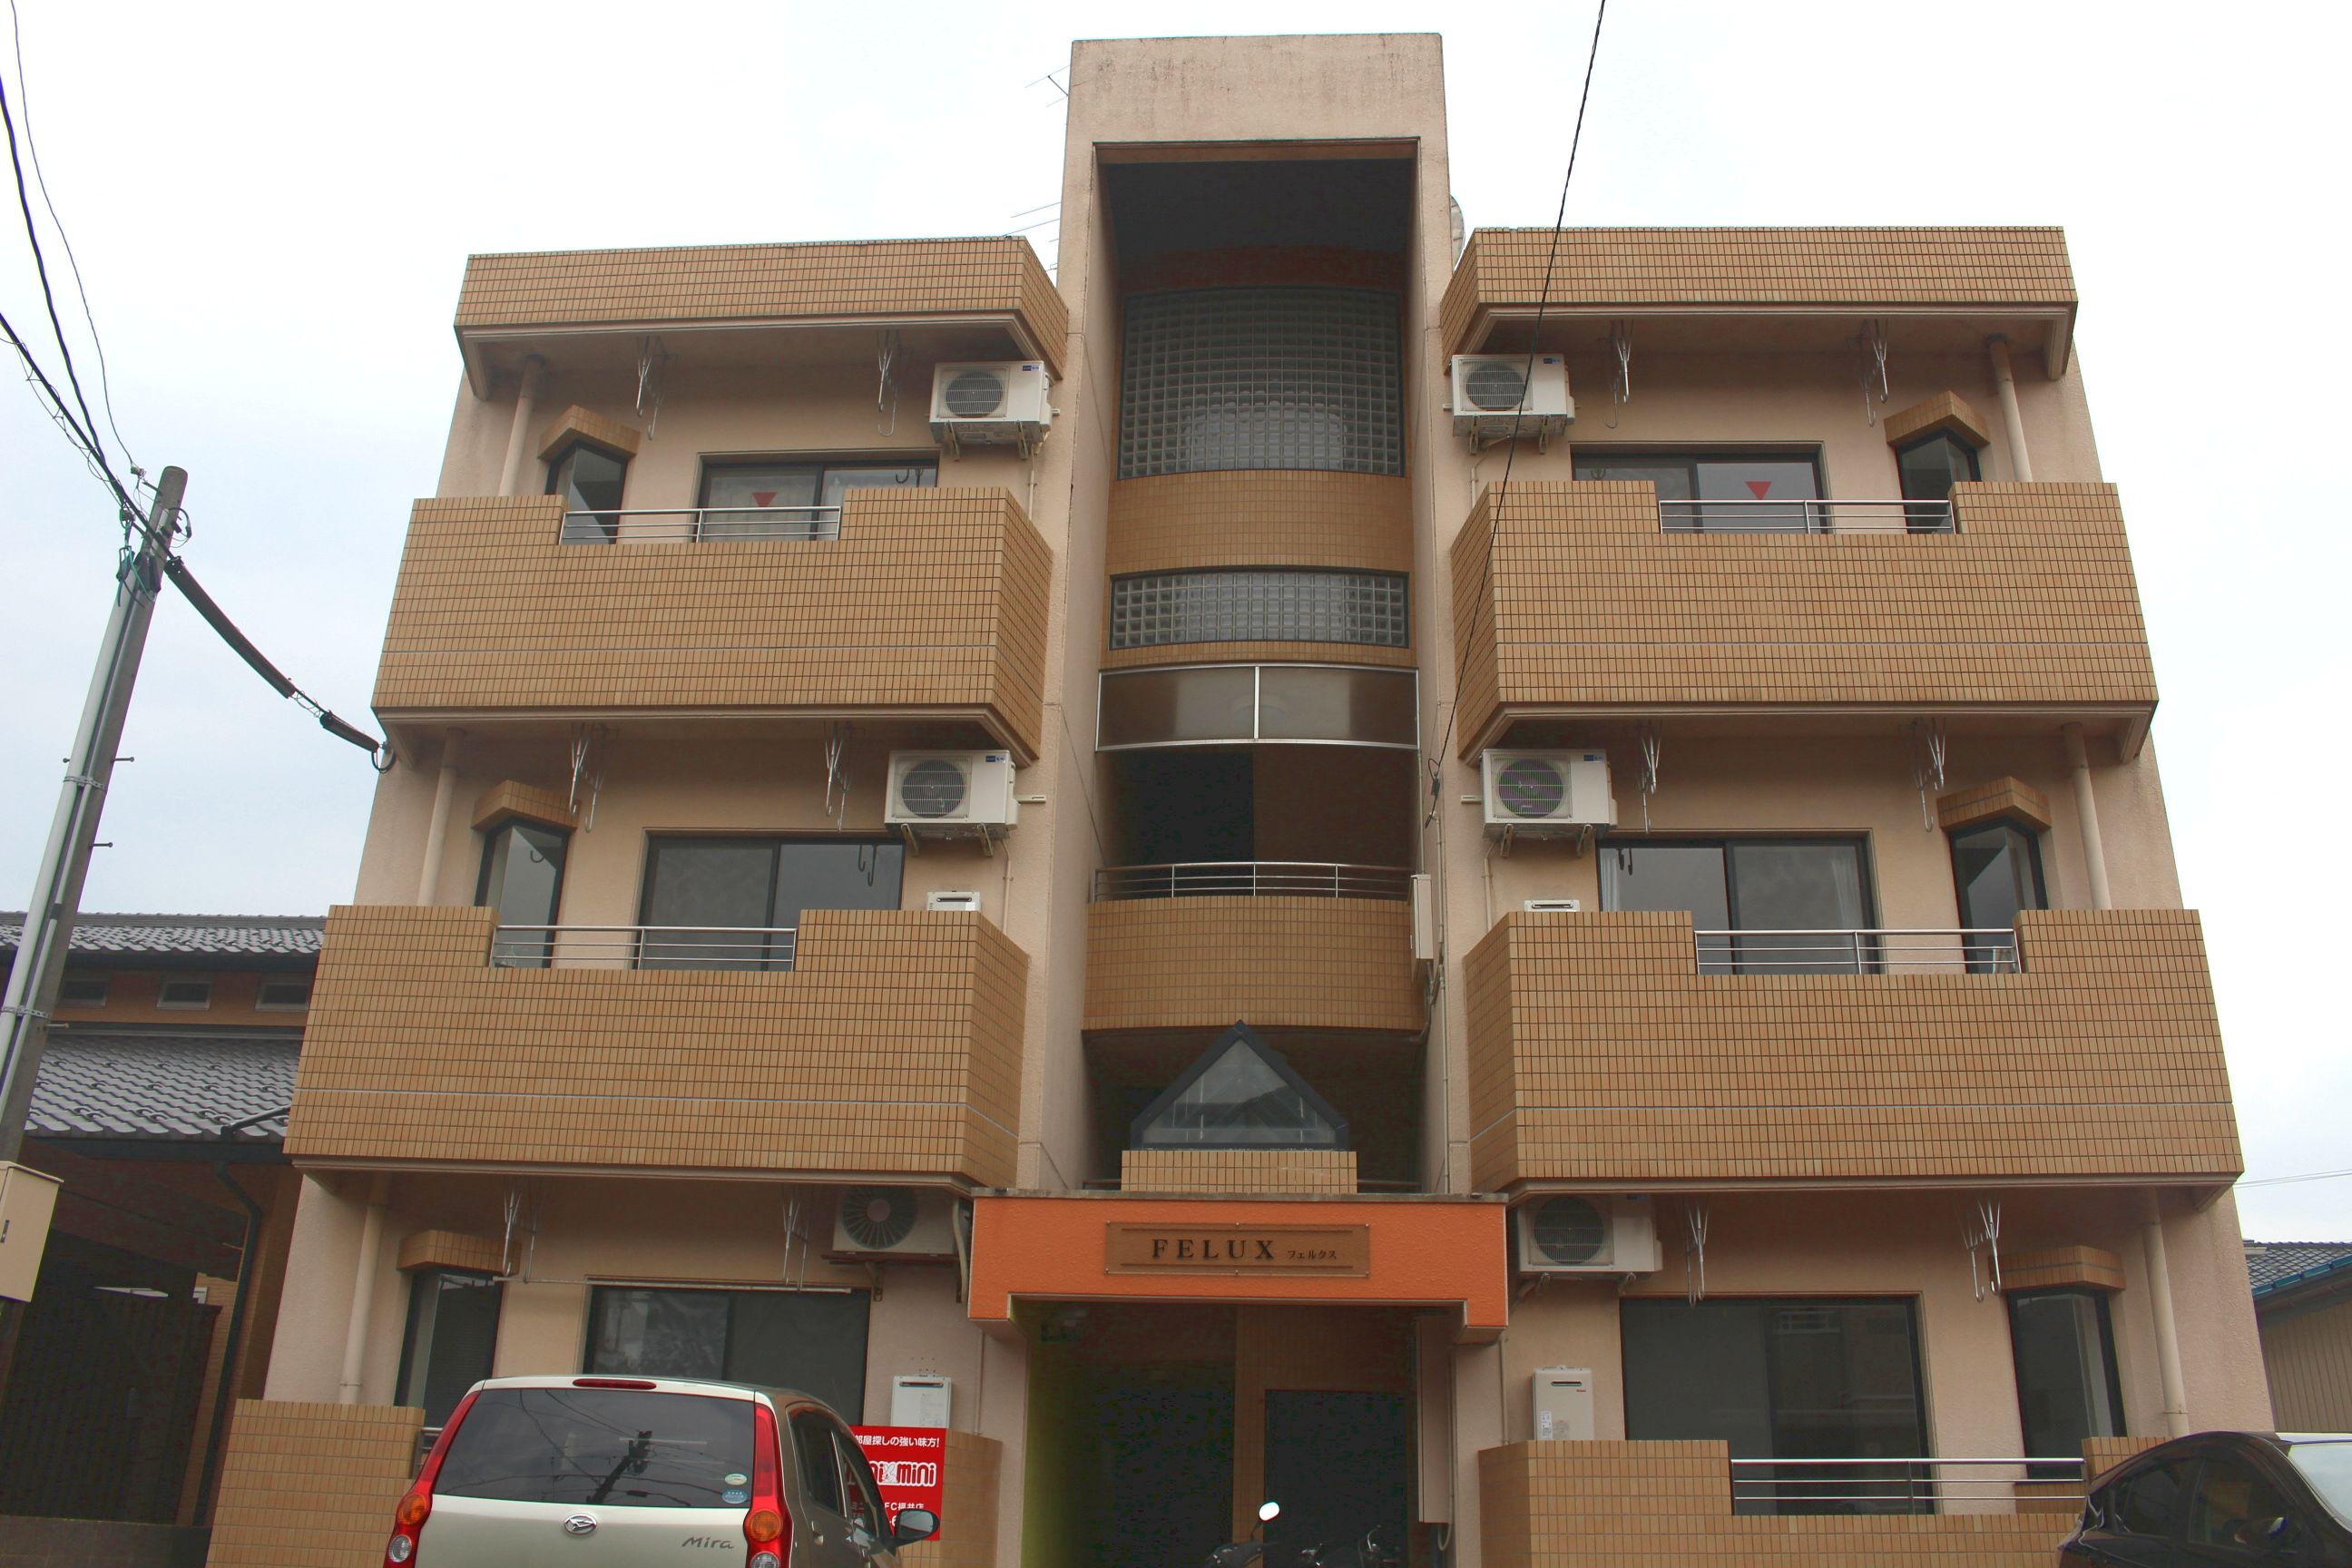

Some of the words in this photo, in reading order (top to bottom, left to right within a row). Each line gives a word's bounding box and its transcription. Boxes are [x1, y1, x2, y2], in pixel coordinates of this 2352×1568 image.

[1152, 1238, 1275, 1260] FELUX
[1287, 1249, 1338, 1260] フェルクス
[681, 1536, 734, 1550] Mira
